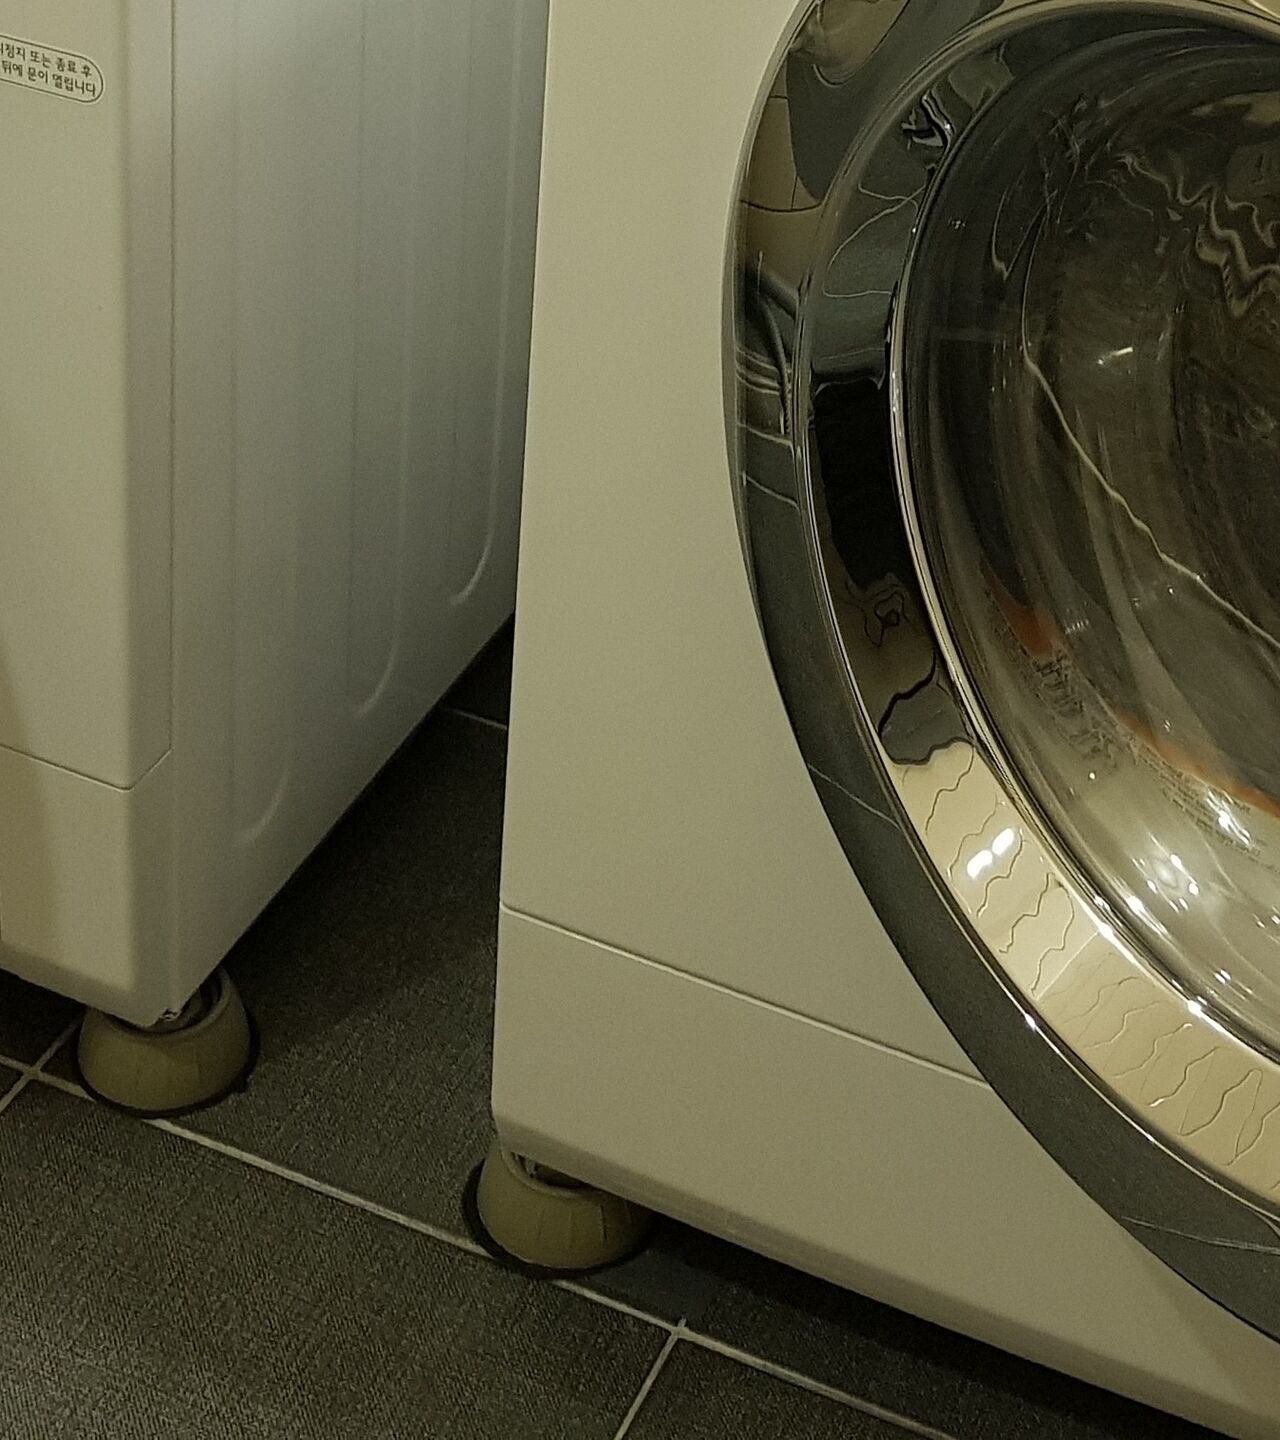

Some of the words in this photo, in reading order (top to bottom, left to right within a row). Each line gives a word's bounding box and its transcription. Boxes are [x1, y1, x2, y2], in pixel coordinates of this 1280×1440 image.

[2, 60, 23, 77] 뒤에
[27, 67, 48, 84] 문이
[52, 74, 96, 97] 열립니다
[30, 50, 51, 68] 또는
[55, 57, 77, 73] 종료
[81, 64, 92, 78] 후
